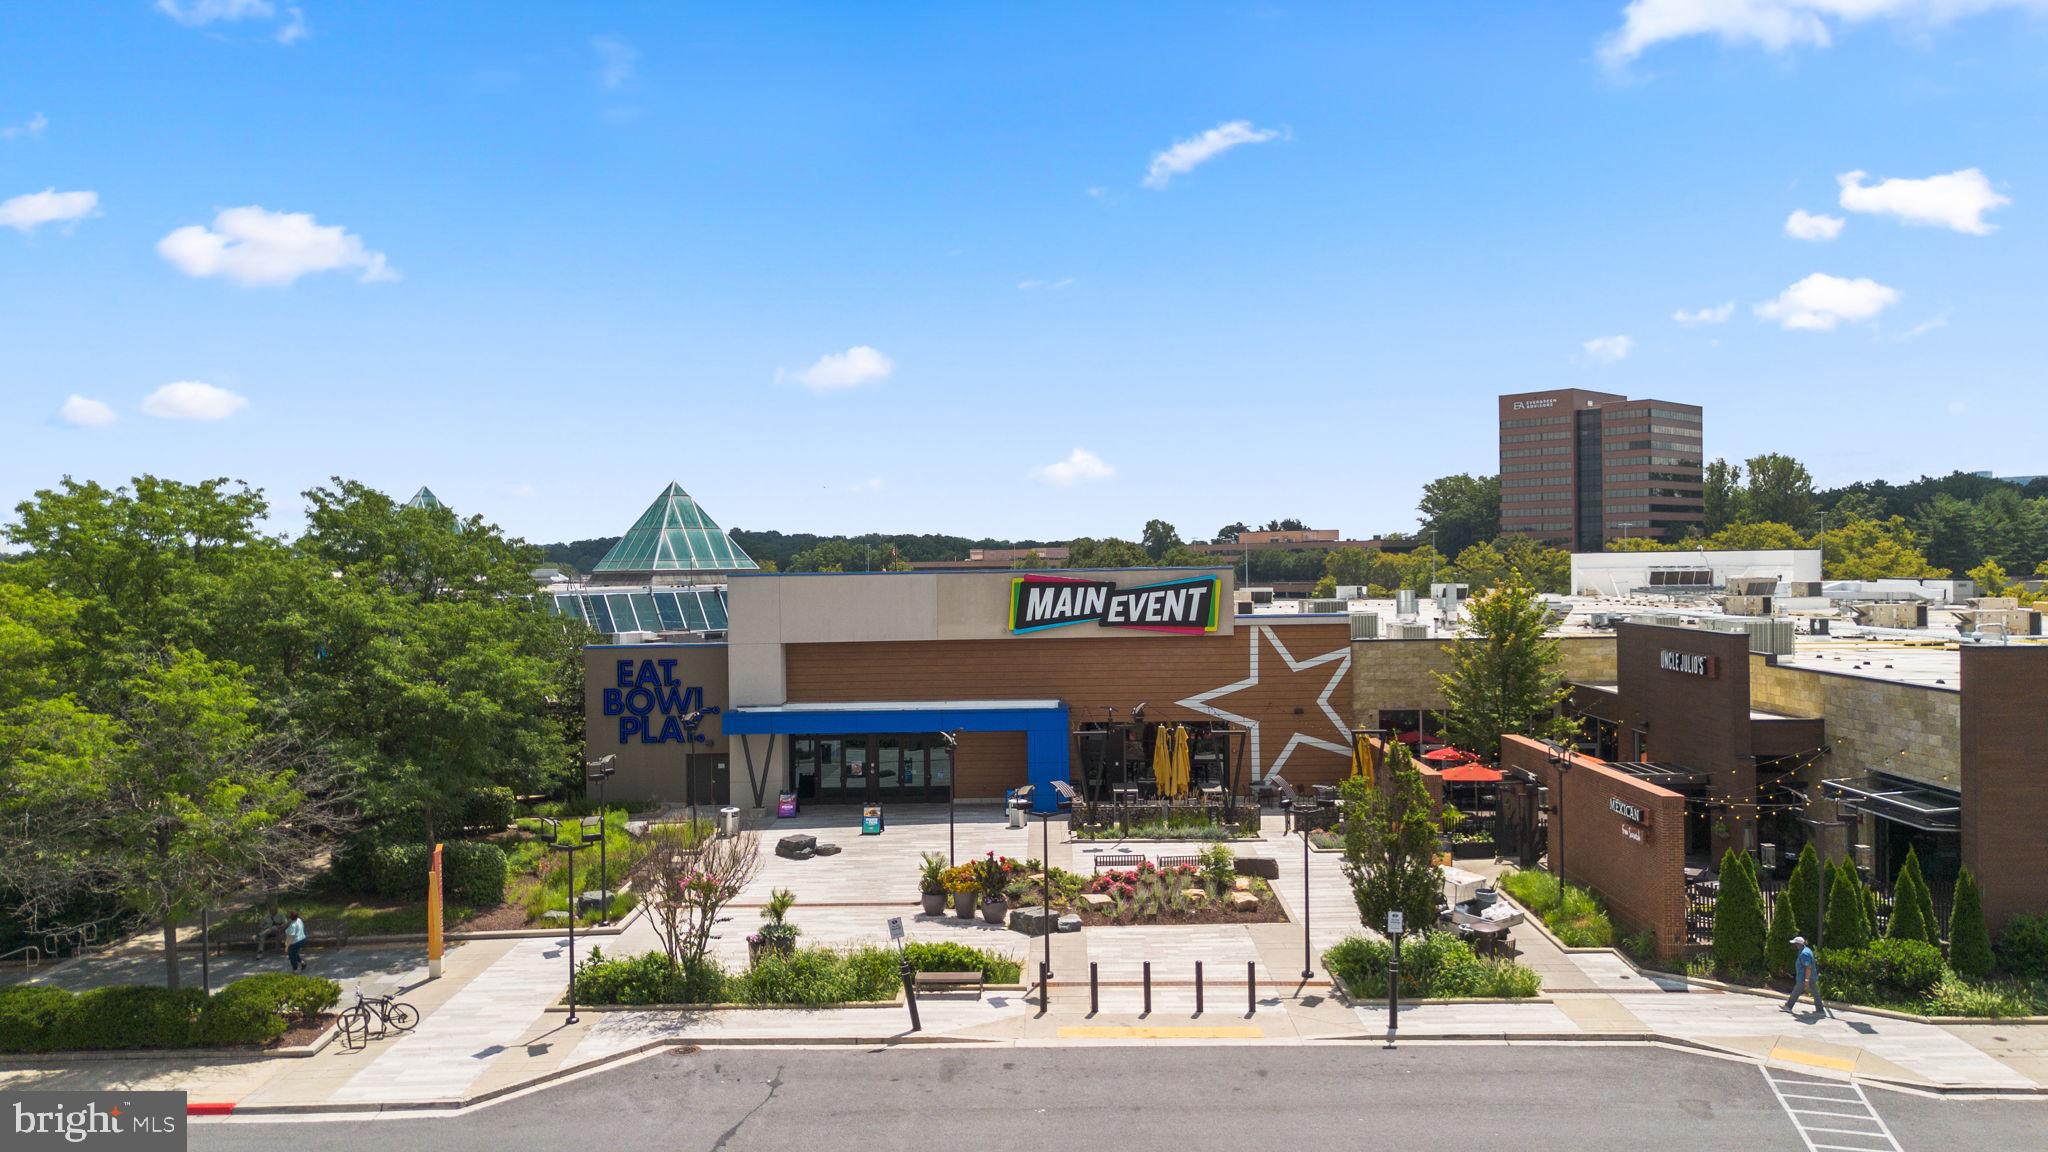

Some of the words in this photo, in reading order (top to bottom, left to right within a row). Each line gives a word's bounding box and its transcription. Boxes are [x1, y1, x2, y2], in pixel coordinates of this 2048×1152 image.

[1025, 586, 1108, 622] MAIN
[1107, 586, 1208, 622] EVENT
[617, 659, 681, 688] EAT.
[1660, 650, 1679, 671] UNCLE
[1680, 654, 1705, 676] JULIO'S
[1609, 797, 1640, 822] MEXICAN
